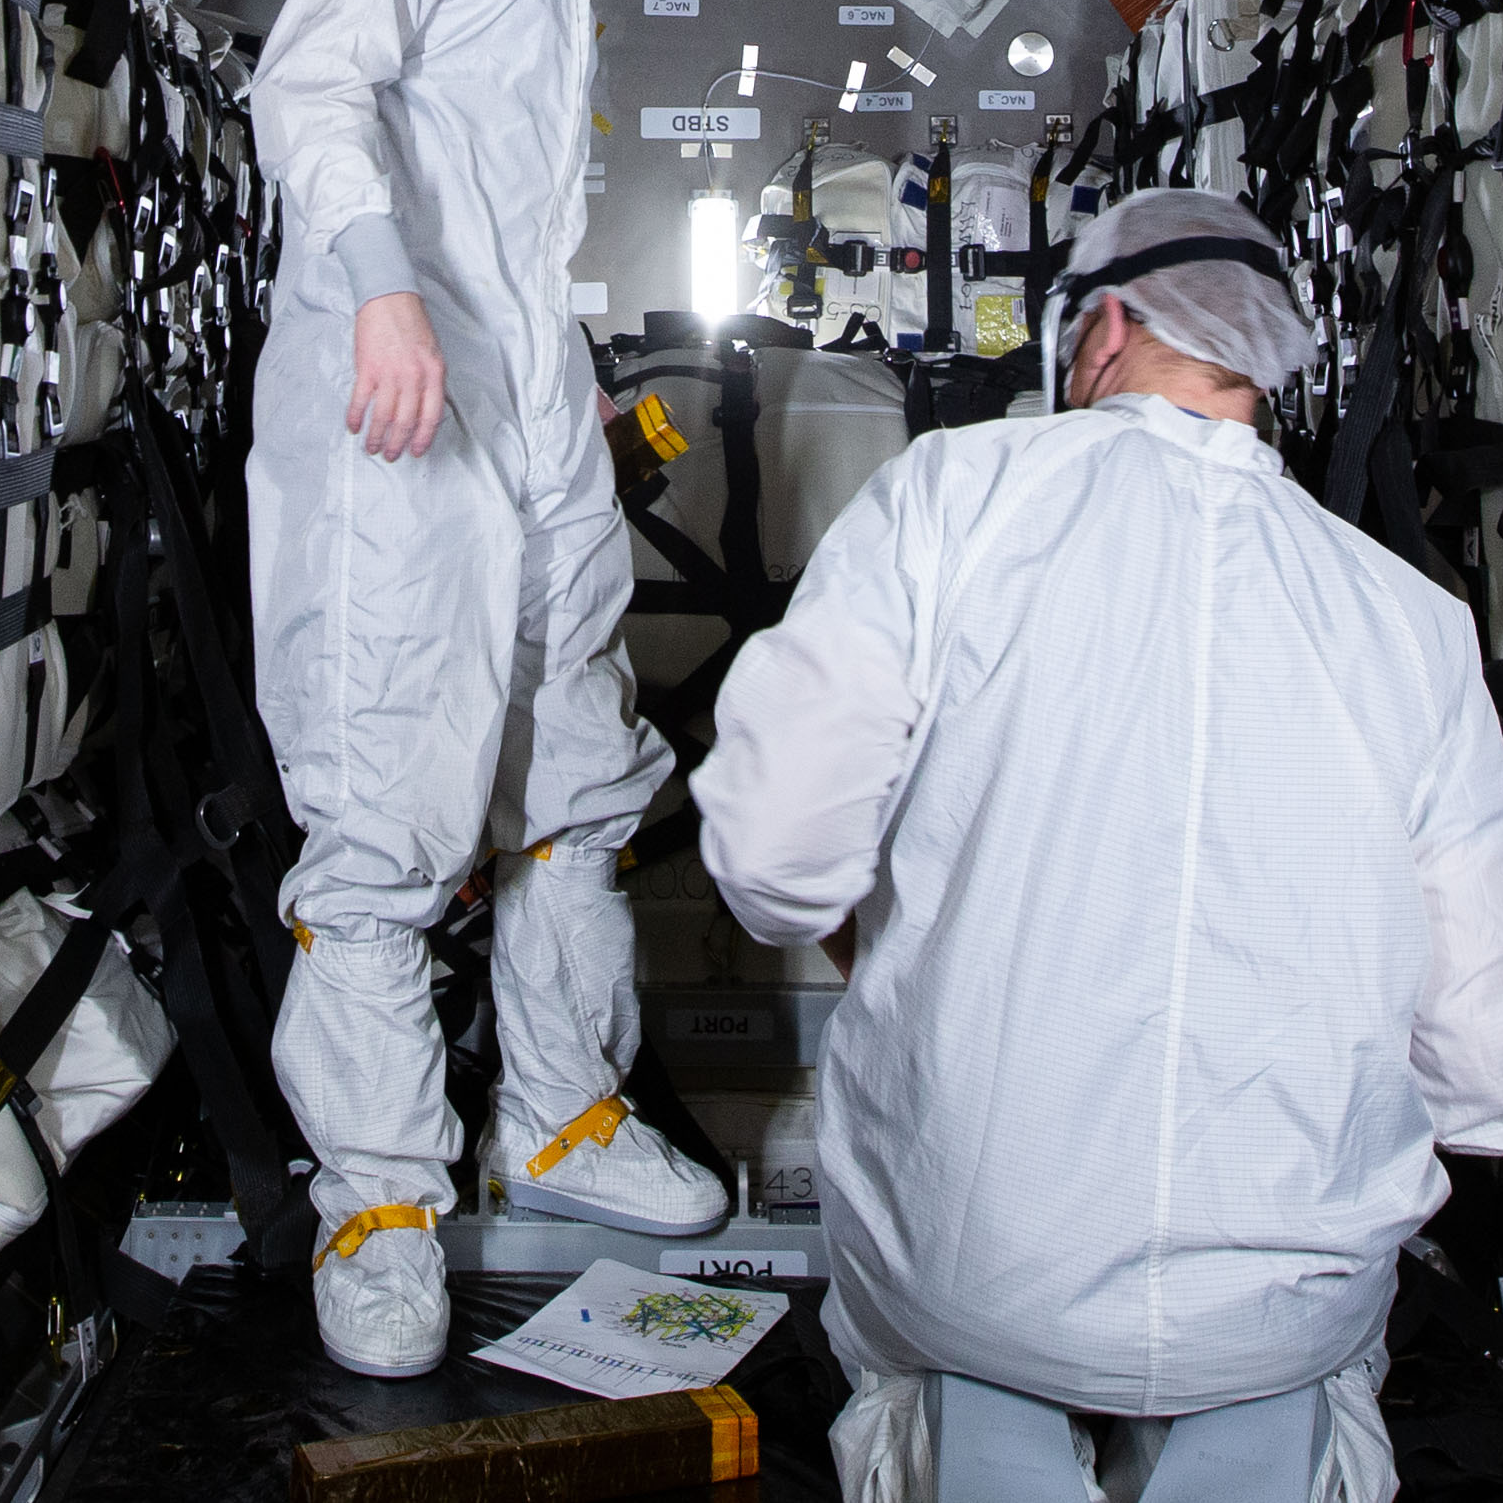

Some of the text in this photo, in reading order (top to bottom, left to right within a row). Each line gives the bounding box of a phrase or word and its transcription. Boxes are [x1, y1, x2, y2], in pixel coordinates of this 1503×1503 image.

[653, 0, 691, 12] NAC_7
[848, 8, 886, 21] NAC_6
[865, 96, 904, 108] NAC_4
[987, 93, 1027, 105] NAC_3
[672, 115, 729, 132] STBD
[878, 255, 887, 264] E
[691, 1016, 748, 1034] PORT
